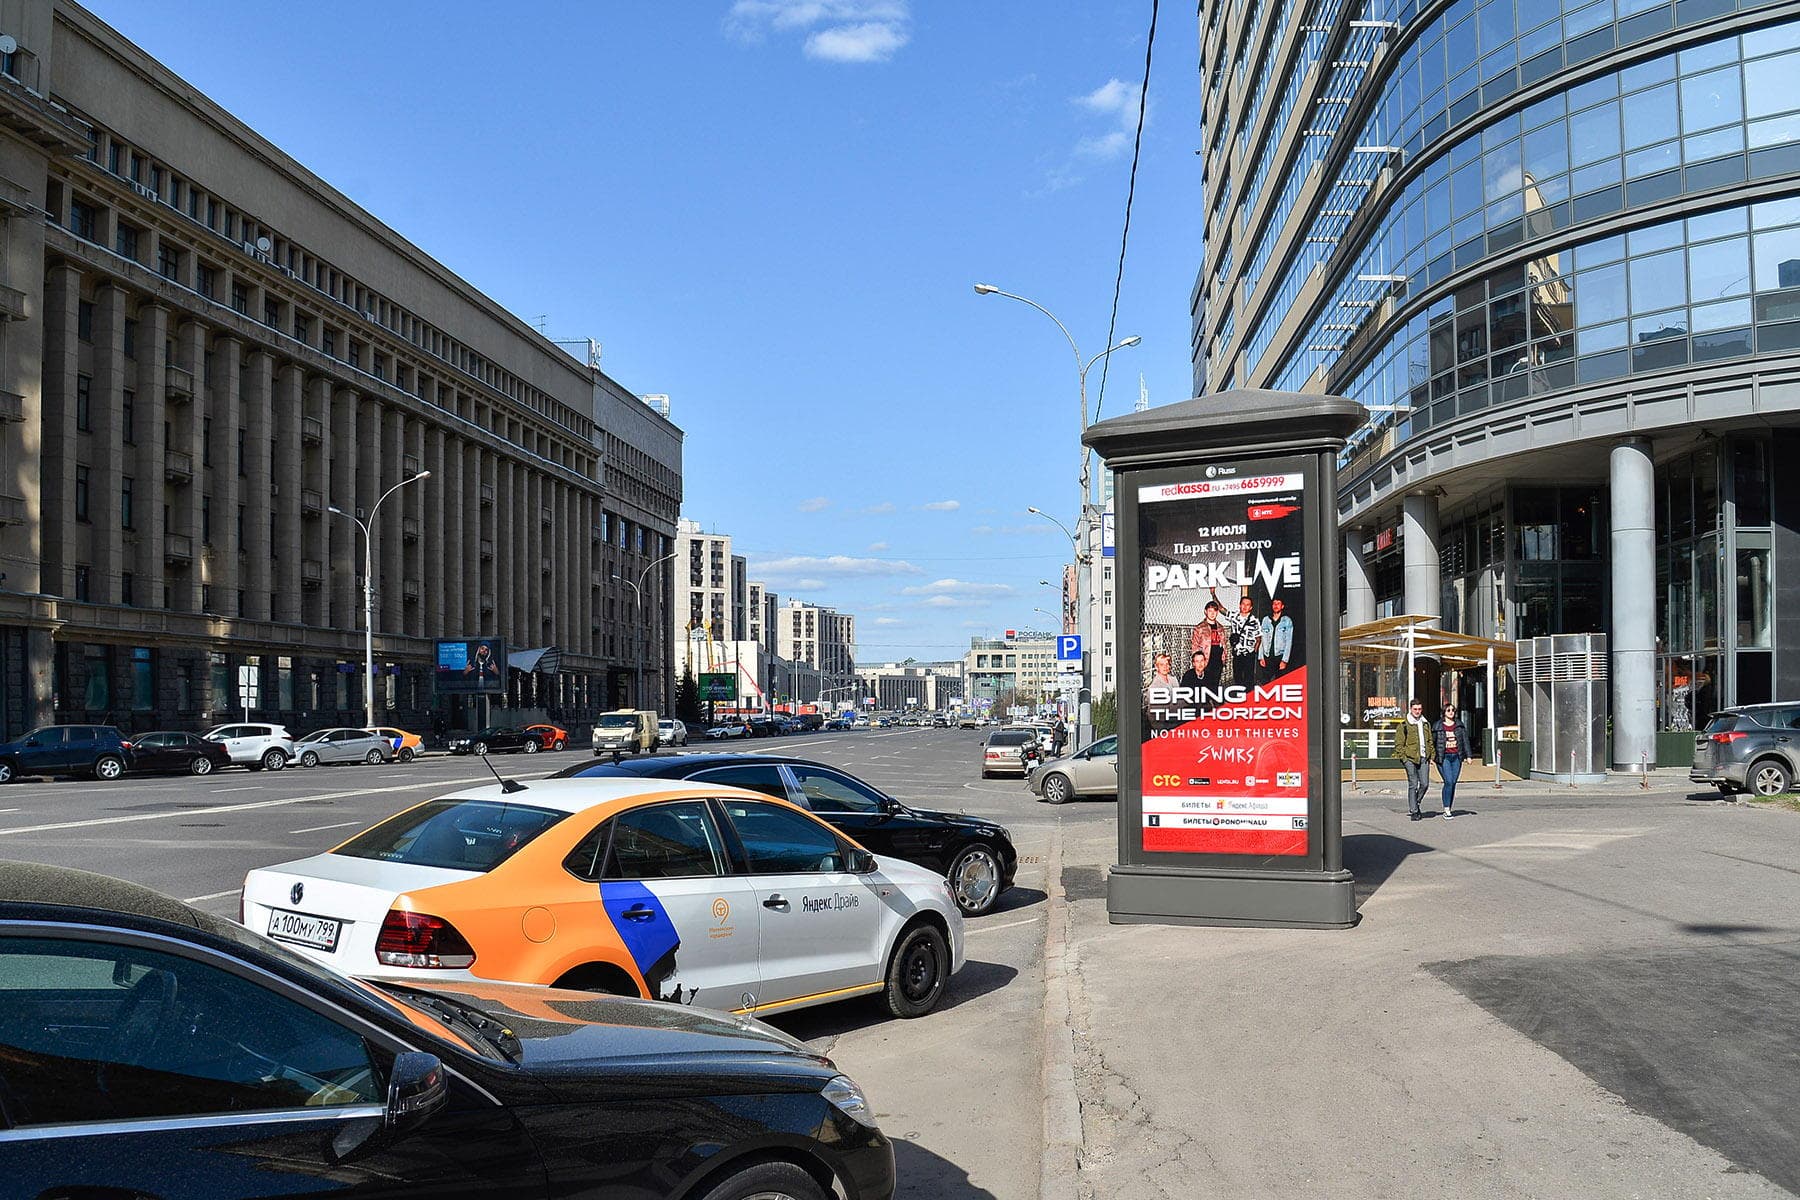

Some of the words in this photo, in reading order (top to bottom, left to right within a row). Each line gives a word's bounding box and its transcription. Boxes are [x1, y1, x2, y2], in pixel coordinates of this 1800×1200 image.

[1218, 467, 1236, 475] Russ
[1198, 526, 1210, 538] 12
[1210, 524, 1247, 537] ИЮЛЯ
[1173, 543, 1209, 557] Парк
[1210, 539, 1272, 555] Горького
[1148, 560, 1232, 591] PARK
[1063, 637, 1078, 658] P
[1149, 685, 1247, 704] BRING
[1254, 684, 1304, 702] ME
[1150, 708, 1197, 721] THE
[1200, 706, 1303, 721] HORIZON
[1150, 728, 1211, 739] NOTHING
[1217, 728, 1240, 738] BUT
[1245, 727, 1299, 738] THIEVES
[1197, 745, 1255, 764] SWMRS
[1181, 801, 1211, 809] БИЛЕТЫ
[802, 895, 833, 913] Яндекс
[833, 893, 860, 911] Драйв
